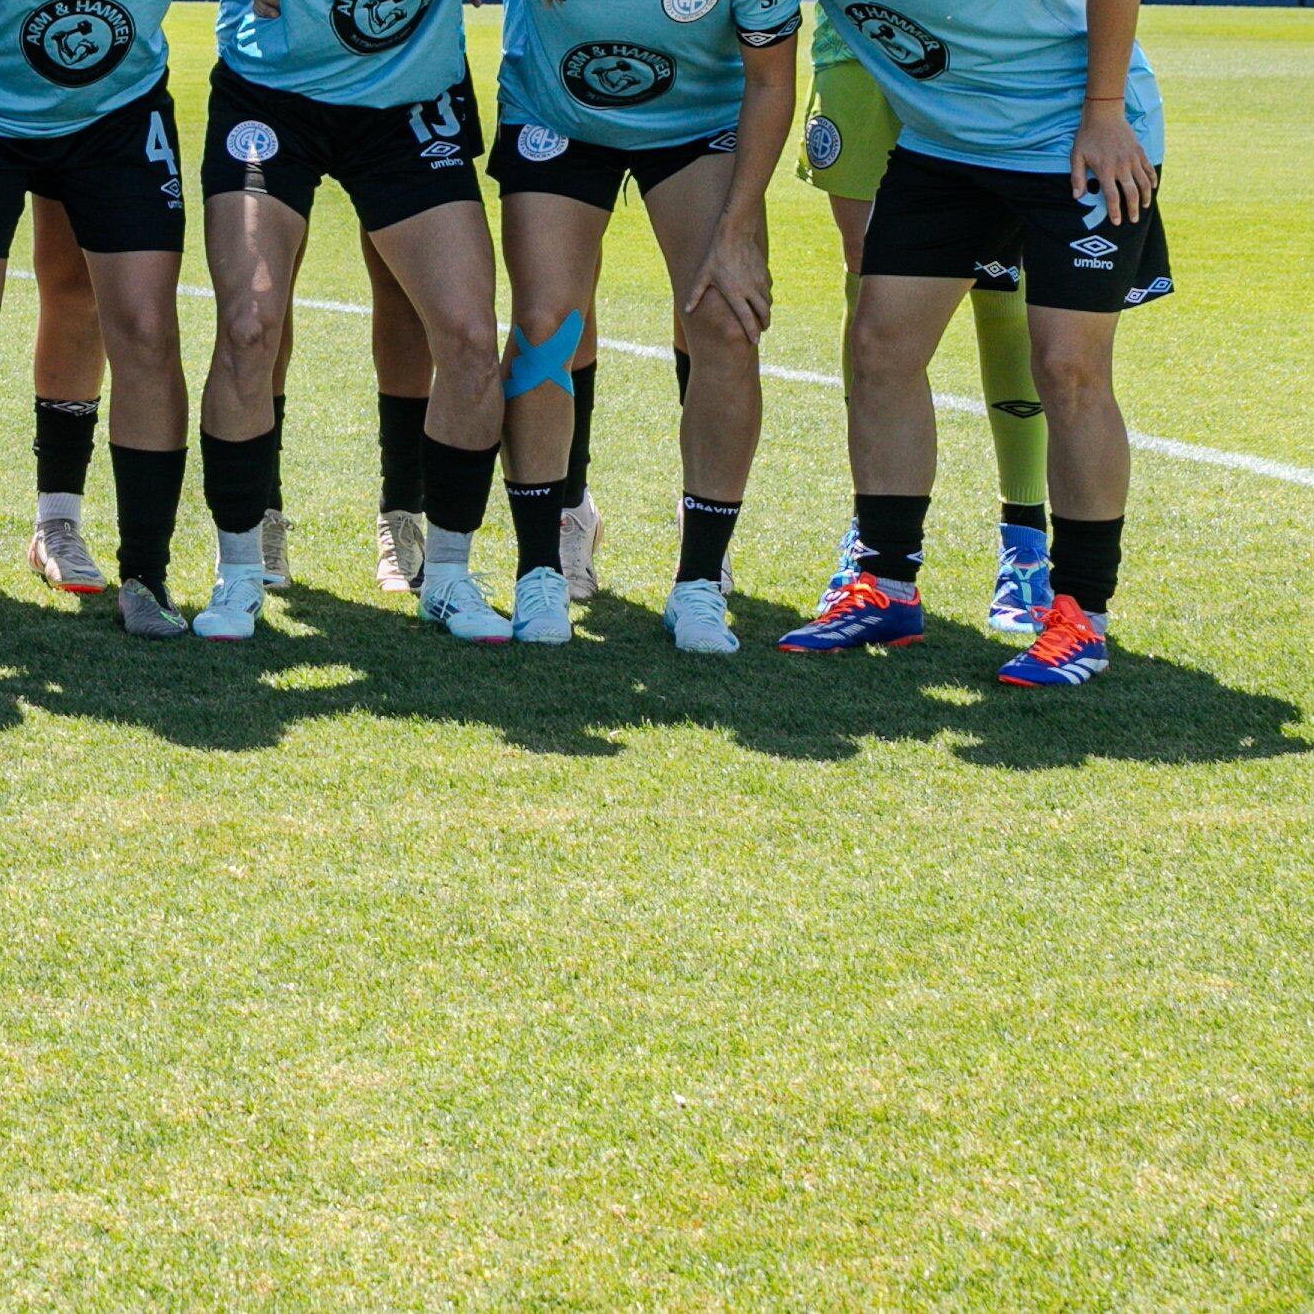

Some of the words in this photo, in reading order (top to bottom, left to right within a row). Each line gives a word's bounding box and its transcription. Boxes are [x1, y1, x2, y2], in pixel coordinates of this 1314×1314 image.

[26, 11, 52, 46] ARM
[55, 2, 70, 16] &
[76, 0, 130, 46] HAMMER
[852, 7, 865, 19] &
[866, 6, 940, 52] HAMMER
[592, 46, 606, 56] &
[613, 45, 671, 80] HAMMER
[146, 111, 179, 176] 4
[431, 156, 464, 170] umbro
[1074, 258, 1114, 270] umbro
[684, 496, 740, 516] GRAVITY
